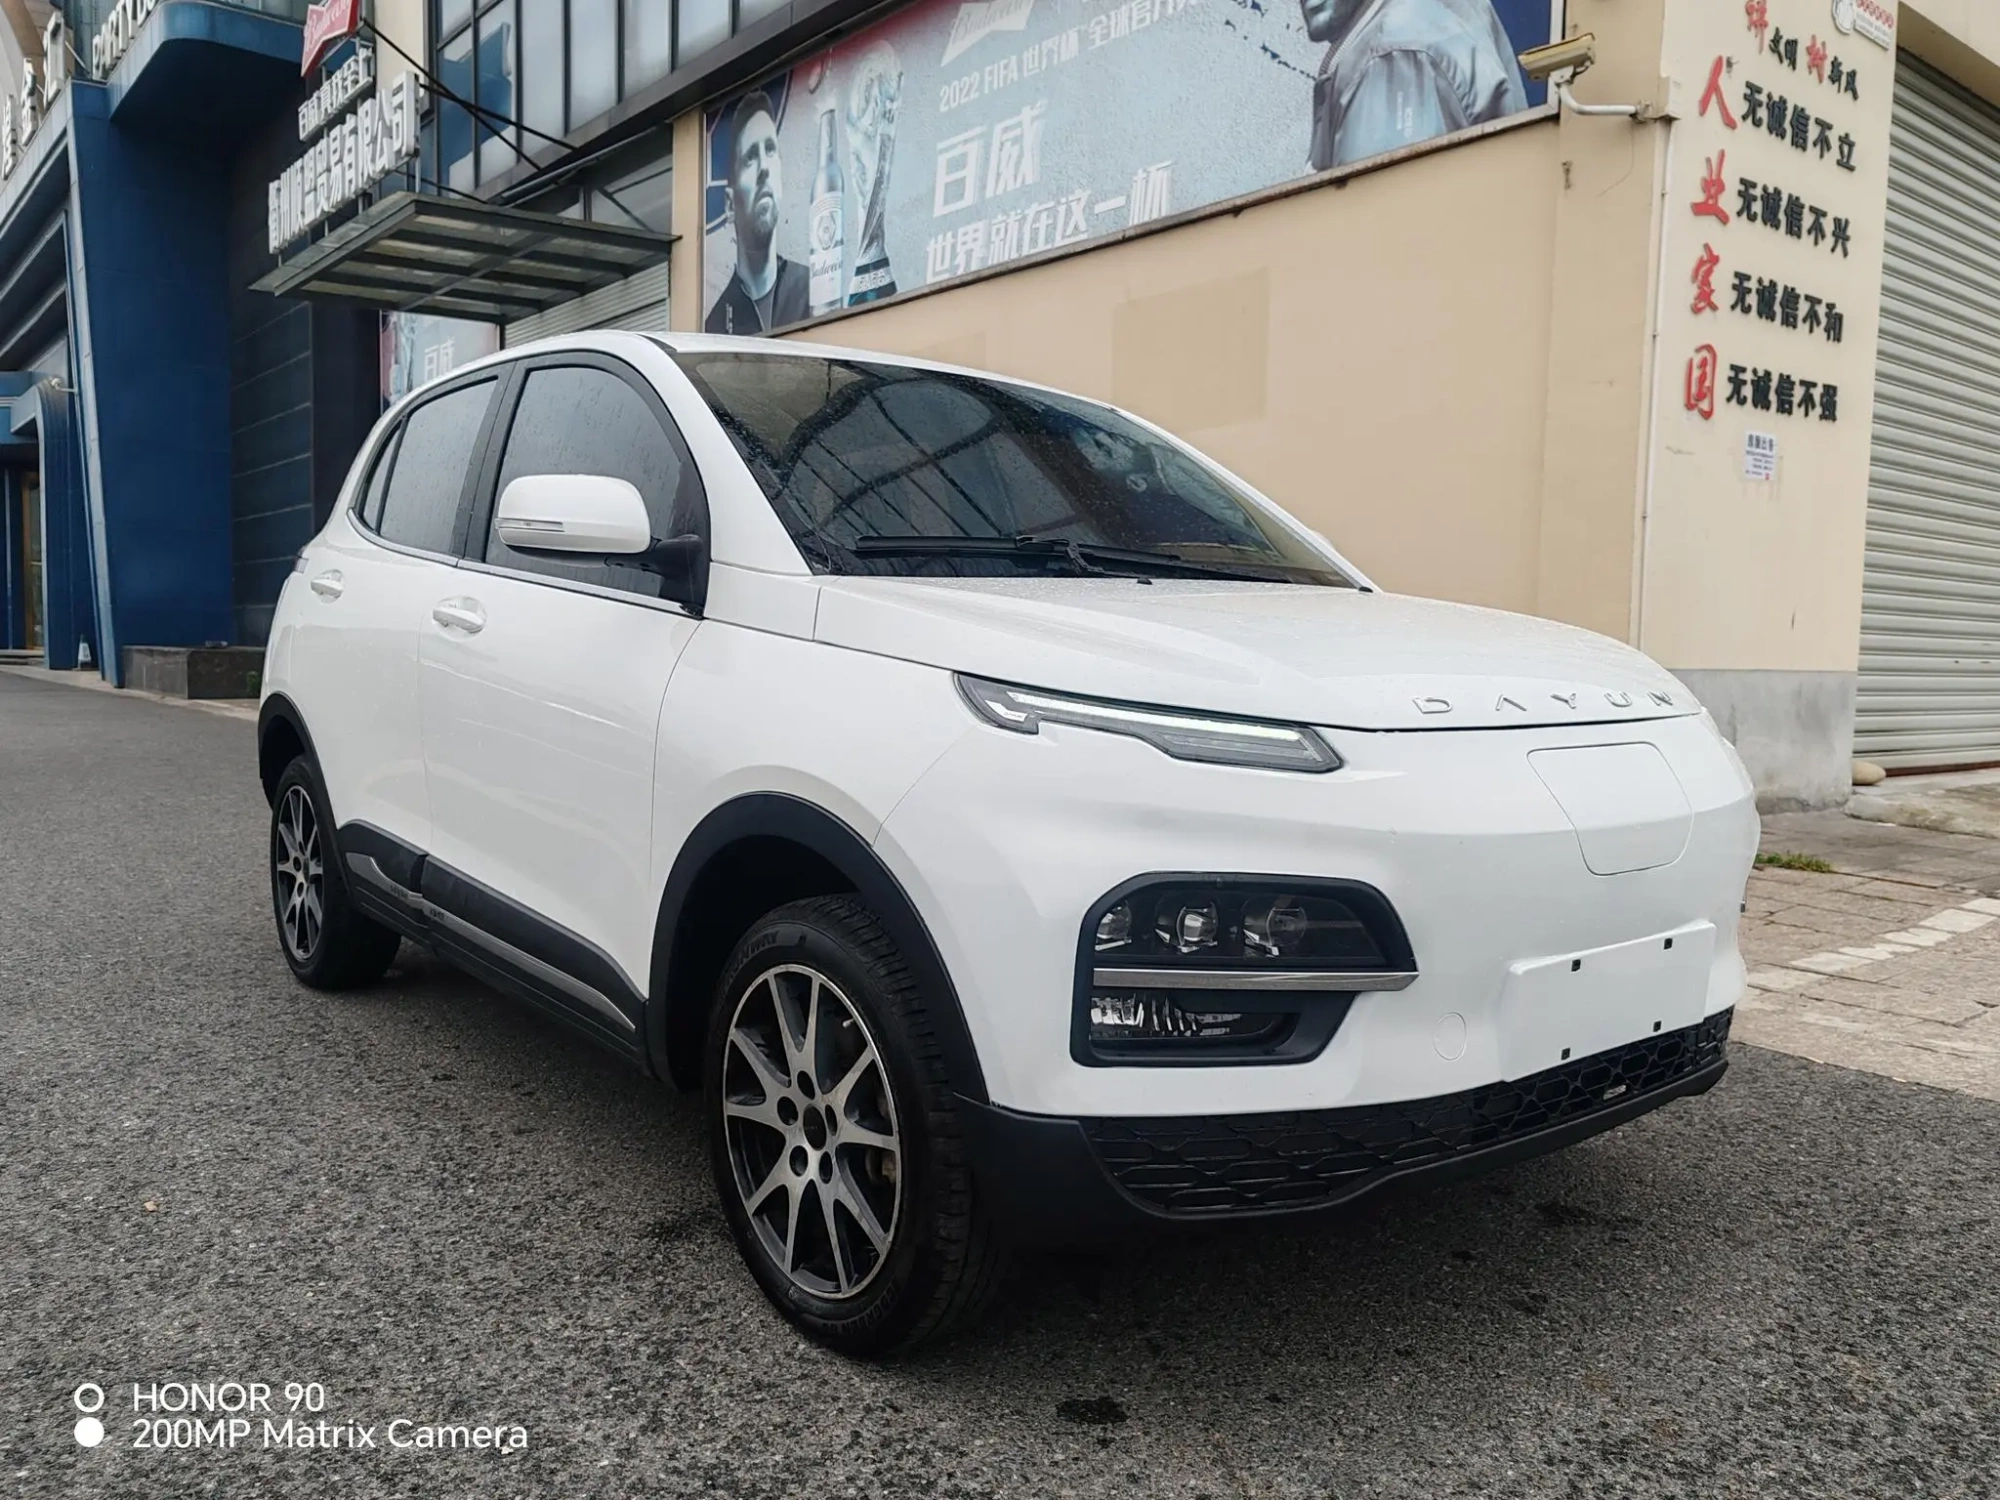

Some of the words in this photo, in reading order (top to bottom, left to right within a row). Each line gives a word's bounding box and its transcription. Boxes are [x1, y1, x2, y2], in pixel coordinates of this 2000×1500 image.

[939, 72, 979, 113] 2022
[983, 55, 1018, 94] FIFA
[933, 100, 1048, 218] 百威
[926, 160, 1175, 285] 世界就在这一杯
[1412, 691, 1674, 714] DAYUN
